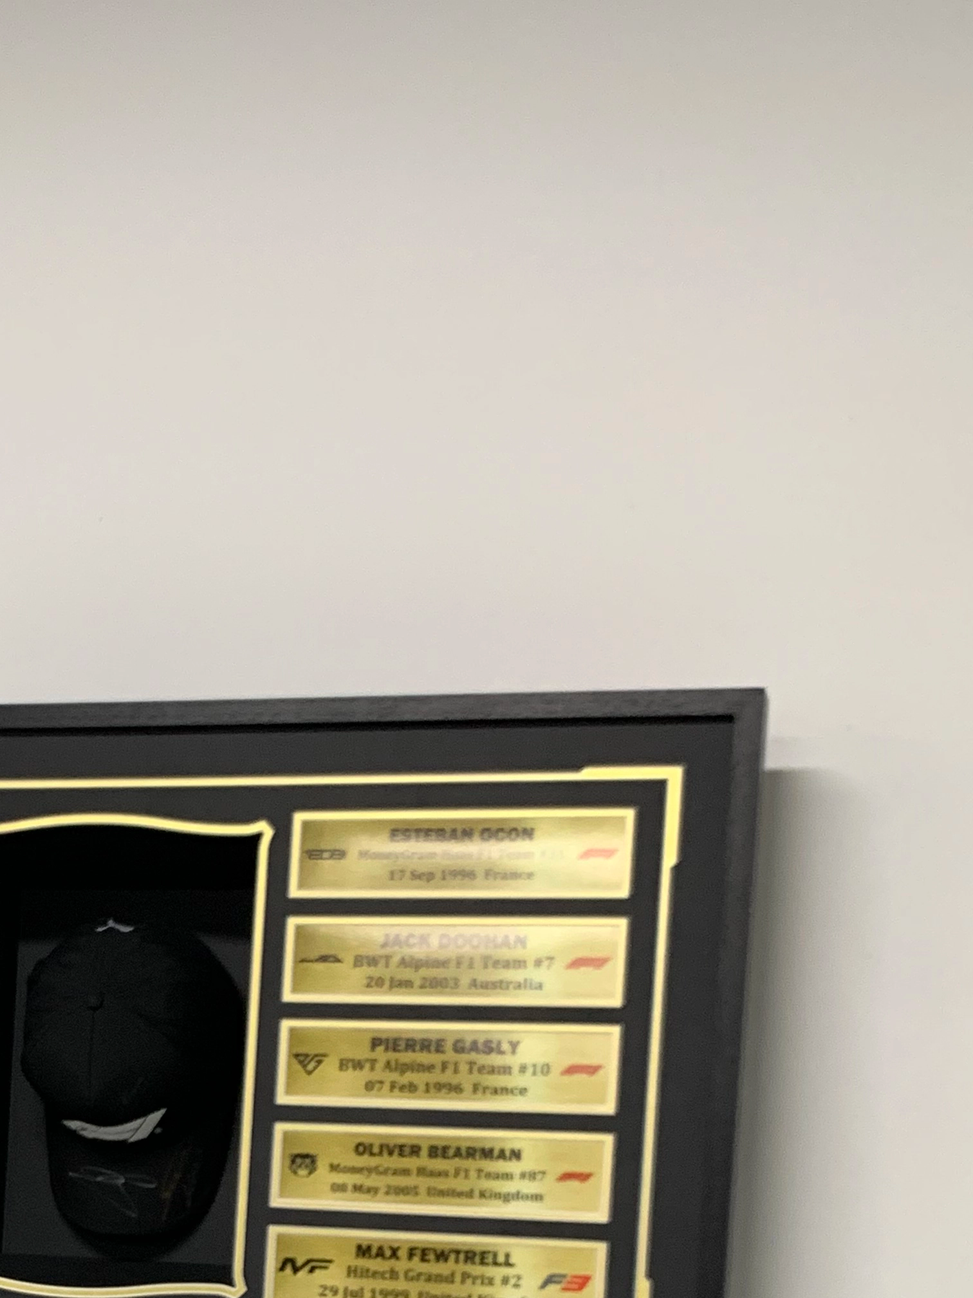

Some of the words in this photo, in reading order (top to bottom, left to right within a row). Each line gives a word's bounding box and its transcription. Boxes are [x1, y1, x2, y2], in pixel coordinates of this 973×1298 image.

[389, 827, 475, 842] ESTEBAN
[388, 869, 406, 881] 17
[410, 869, 436, 883] Sep
[483, 869, 535, 881] France
[380, 934, 430, 949] JACK
[353, 955, 393, 968] BWT
[396, 955, 451, 972] Alpine
[455, 955, 476, 969] F1
[482, 955, 527, 969] Team
[533, 956, 555, 970] #7
[365, 976, 385, 989] 20
[389, 976, 415, 991] Jan
[468, 977, 544, 991] Australia
[370, 1037, 447, 1054] PIERRE
[452, 1038, 521, 1056] GASLY
[338, 1058, 378, 1073] BWT
[382, 1059, 437, 1077] Alpine
[440, 1060, 460, 1075] F1
[466, 1061, 513, 1076] Team
[518, 1062, 551, 1077] #10
[364, 1080, 385, 1093] 07
[389, 1080, 419, 1094] Feb
[425, 1081, 464, 1095] 1996
[472, 1082, 528, 1097] France
[354, 1142, 422, 1158] OLIVER
[427, 1144, 522, 1161] BEARMAN
[454, 1166, 471, 1180] F1
[475, 1167, 514, 1181] Team
[519, 1169, 547, 1182] #87
[351, 1183, 381, 1197] May
[426, 1185, 475, 1200] United
[478, 1188, 545, 1204] Kingdom
[355, 1243, 401, 1261] MAX
[406, 1246, 515, 1268] FEWTRELL
[346, 1264, 400, 1281] Hitech
[404, 1269, 455, 1284] Grand
[460, 1271, 495, 1286] Prix
[500, 1274, 522, 1289] #2
[318, 1284, 339, 1298] 29
